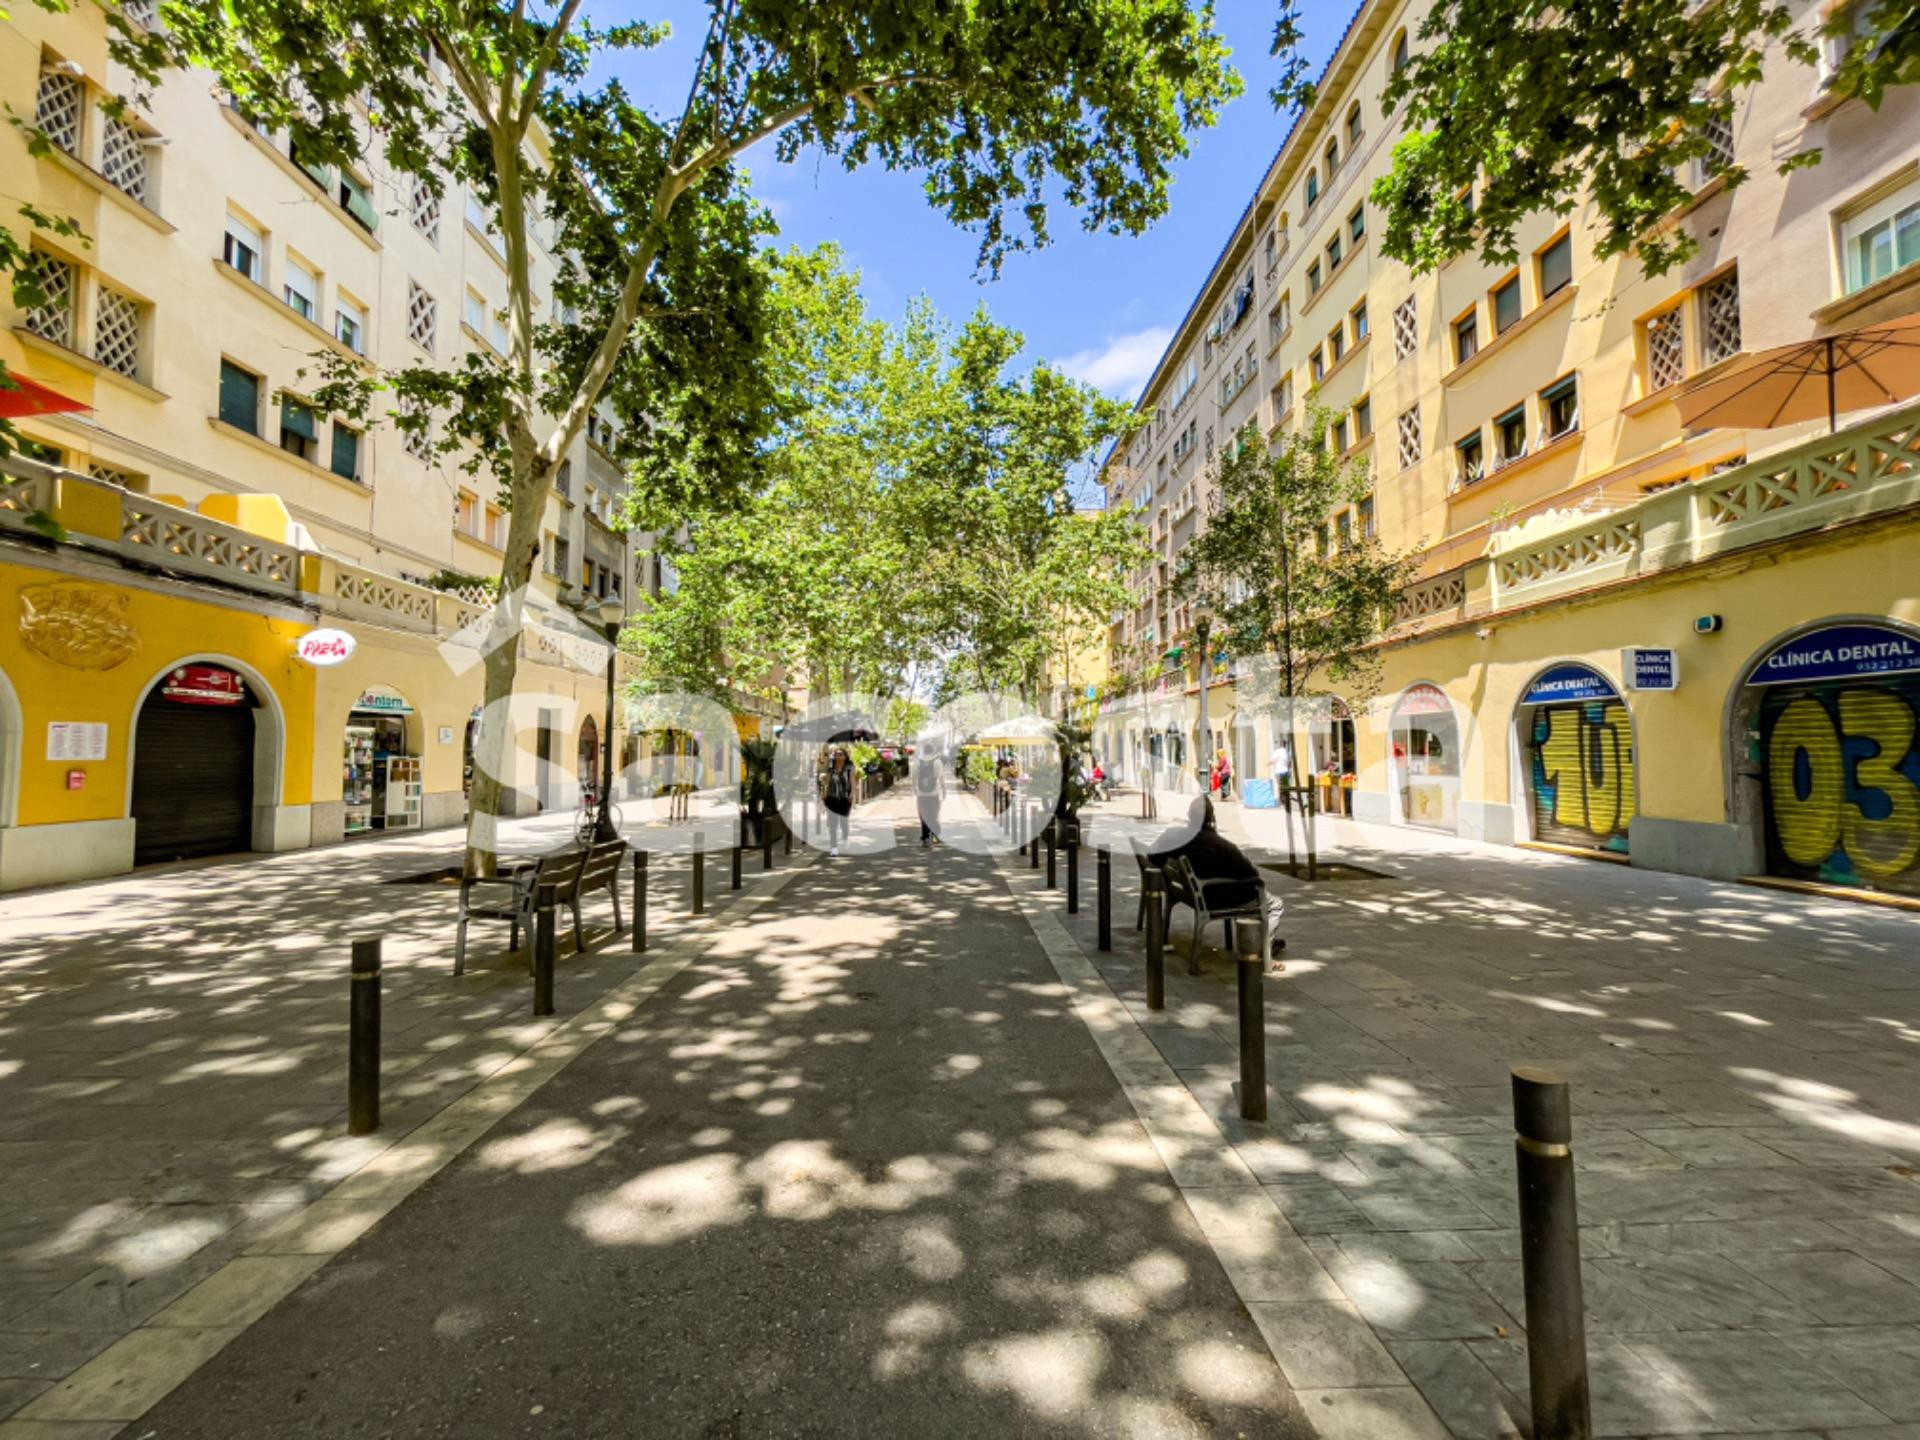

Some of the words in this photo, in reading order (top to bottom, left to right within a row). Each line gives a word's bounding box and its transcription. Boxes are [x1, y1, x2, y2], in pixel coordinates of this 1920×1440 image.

[1767, 648, 1834, 668] CLÍNICA
[1837, 641, 1915, 661] DENTAL
[1565, 676, 1601, 690] DENTAL
[1768, 690, 1920, 877] 03
